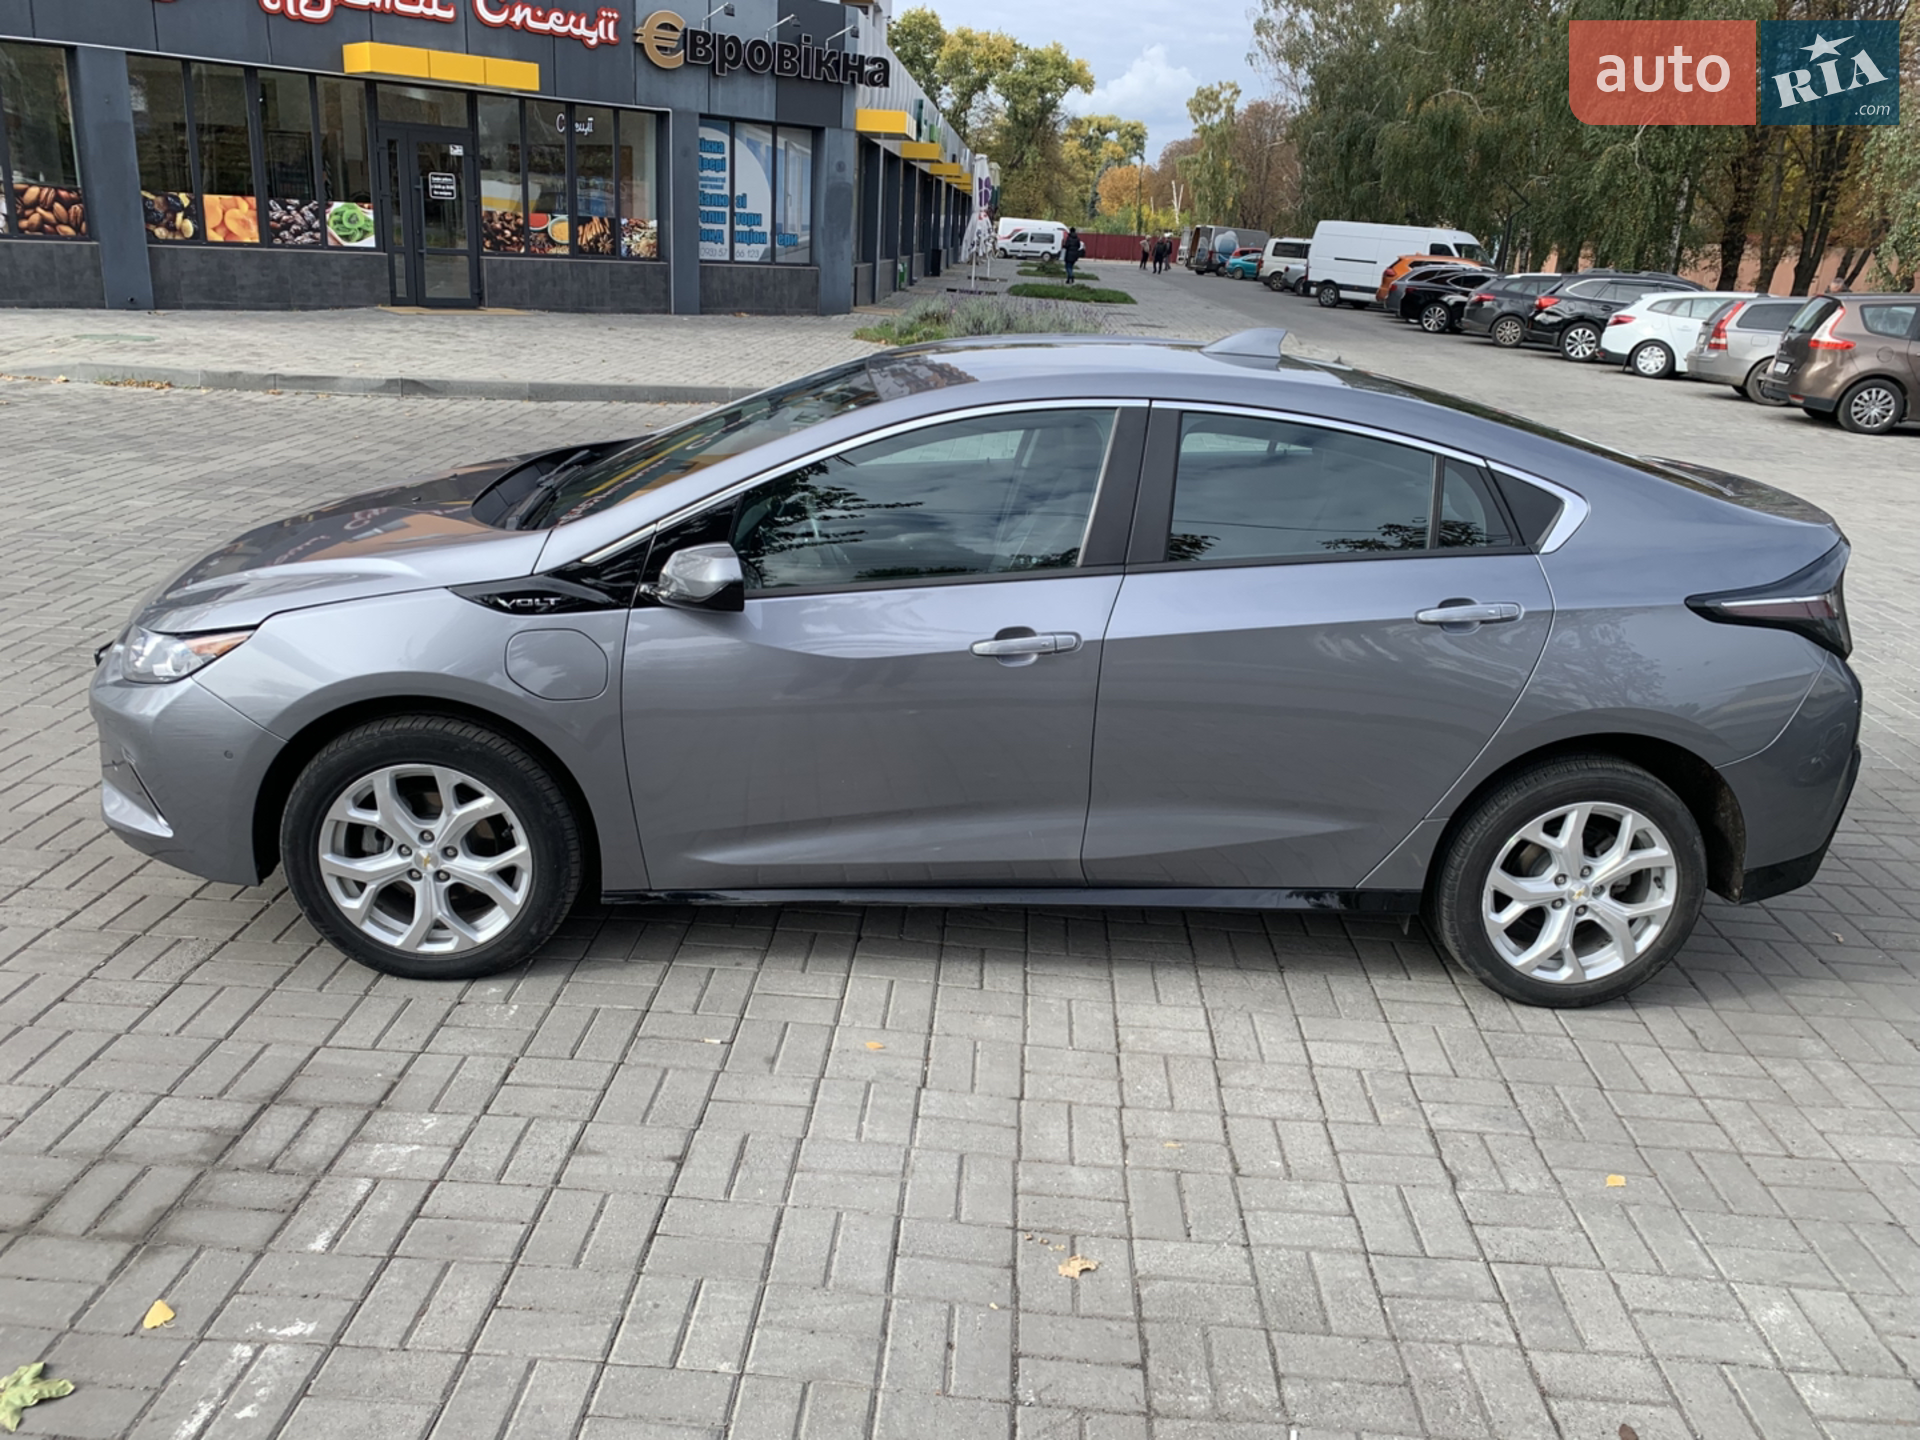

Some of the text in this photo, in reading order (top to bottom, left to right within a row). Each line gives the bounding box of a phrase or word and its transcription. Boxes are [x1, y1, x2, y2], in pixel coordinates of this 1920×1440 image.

[556, 113, 593, 136] Сеції
[699, 138, 724, 154] ікна
[496, 597, 561, 610] VOLT
